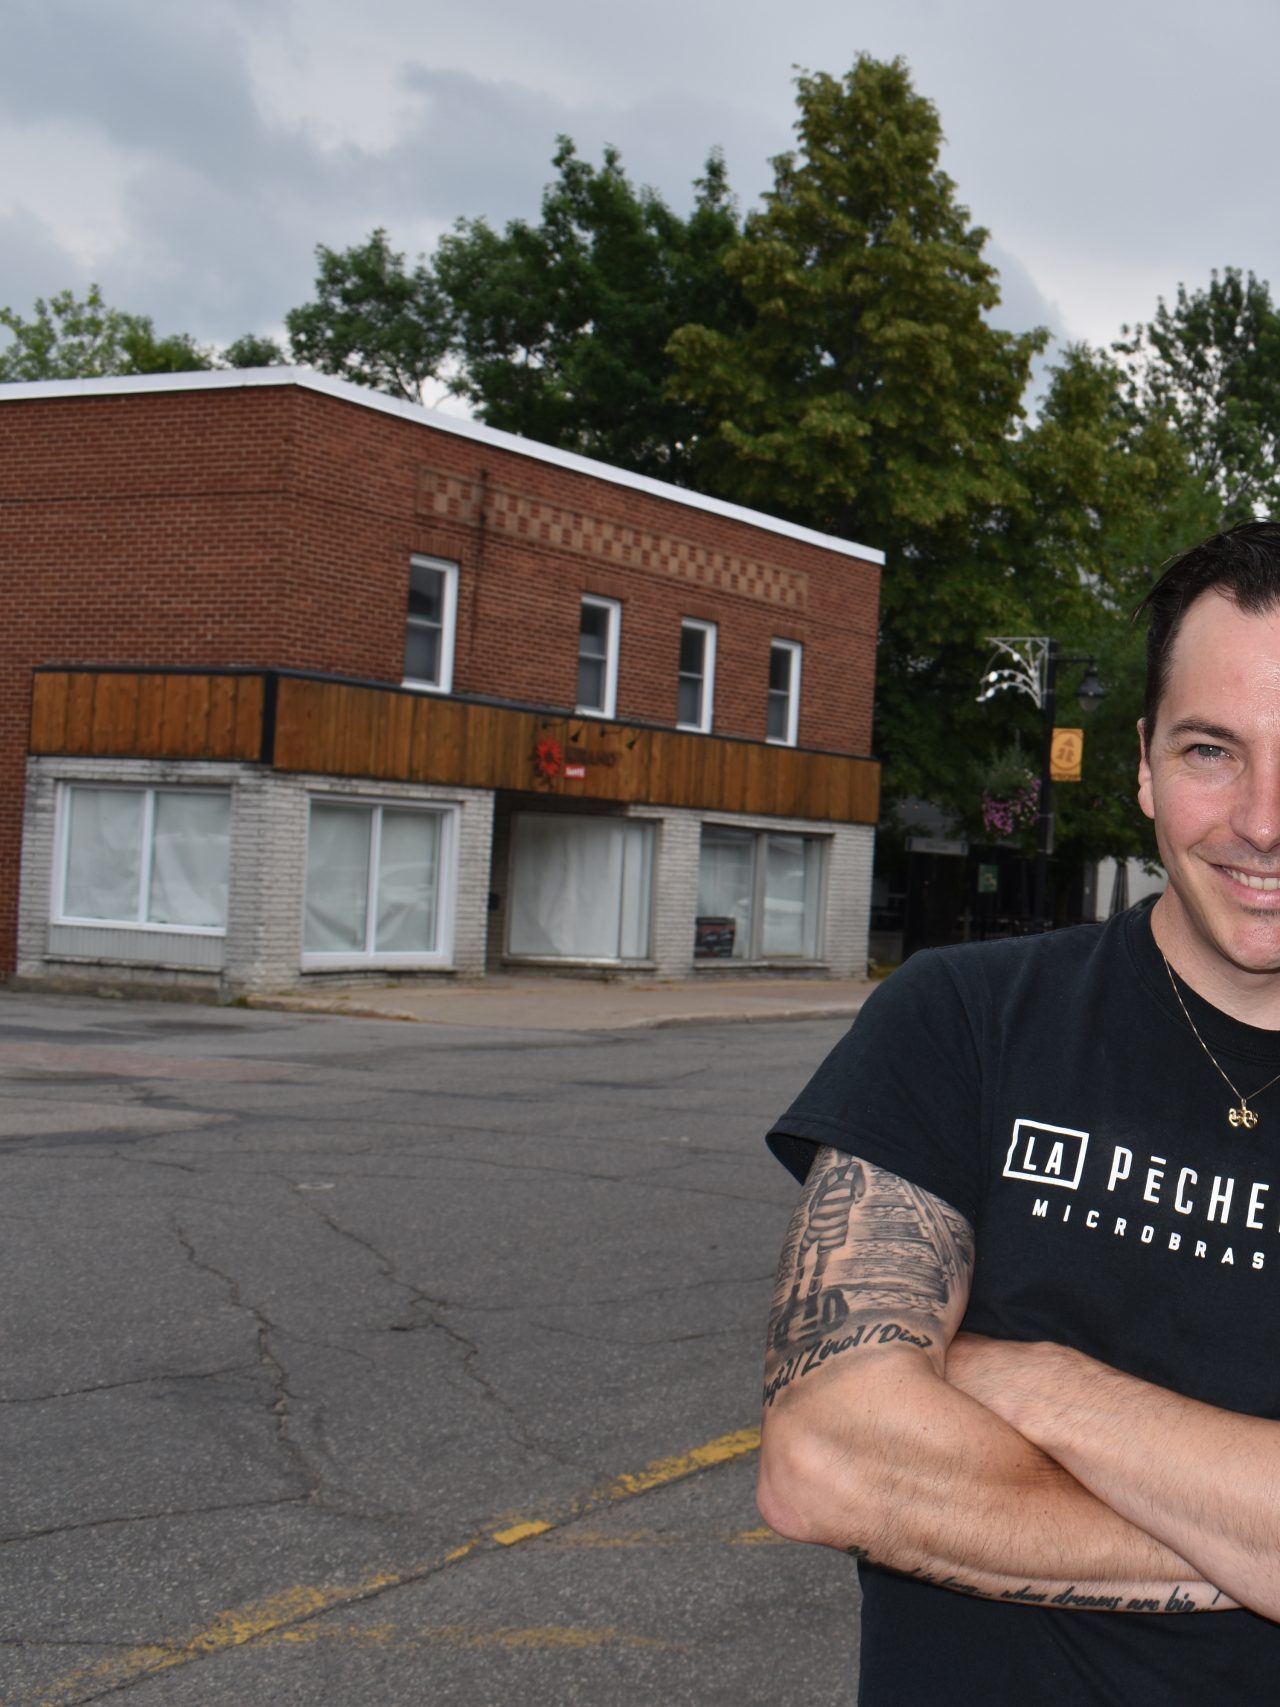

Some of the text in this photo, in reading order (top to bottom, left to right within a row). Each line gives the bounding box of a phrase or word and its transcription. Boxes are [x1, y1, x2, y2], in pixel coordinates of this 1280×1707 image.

[1022, 1136, 1064, 1176] LA
[1051, 1585, 1123, 1610] dreams
[1126, 1598, 1161, 1611] are
